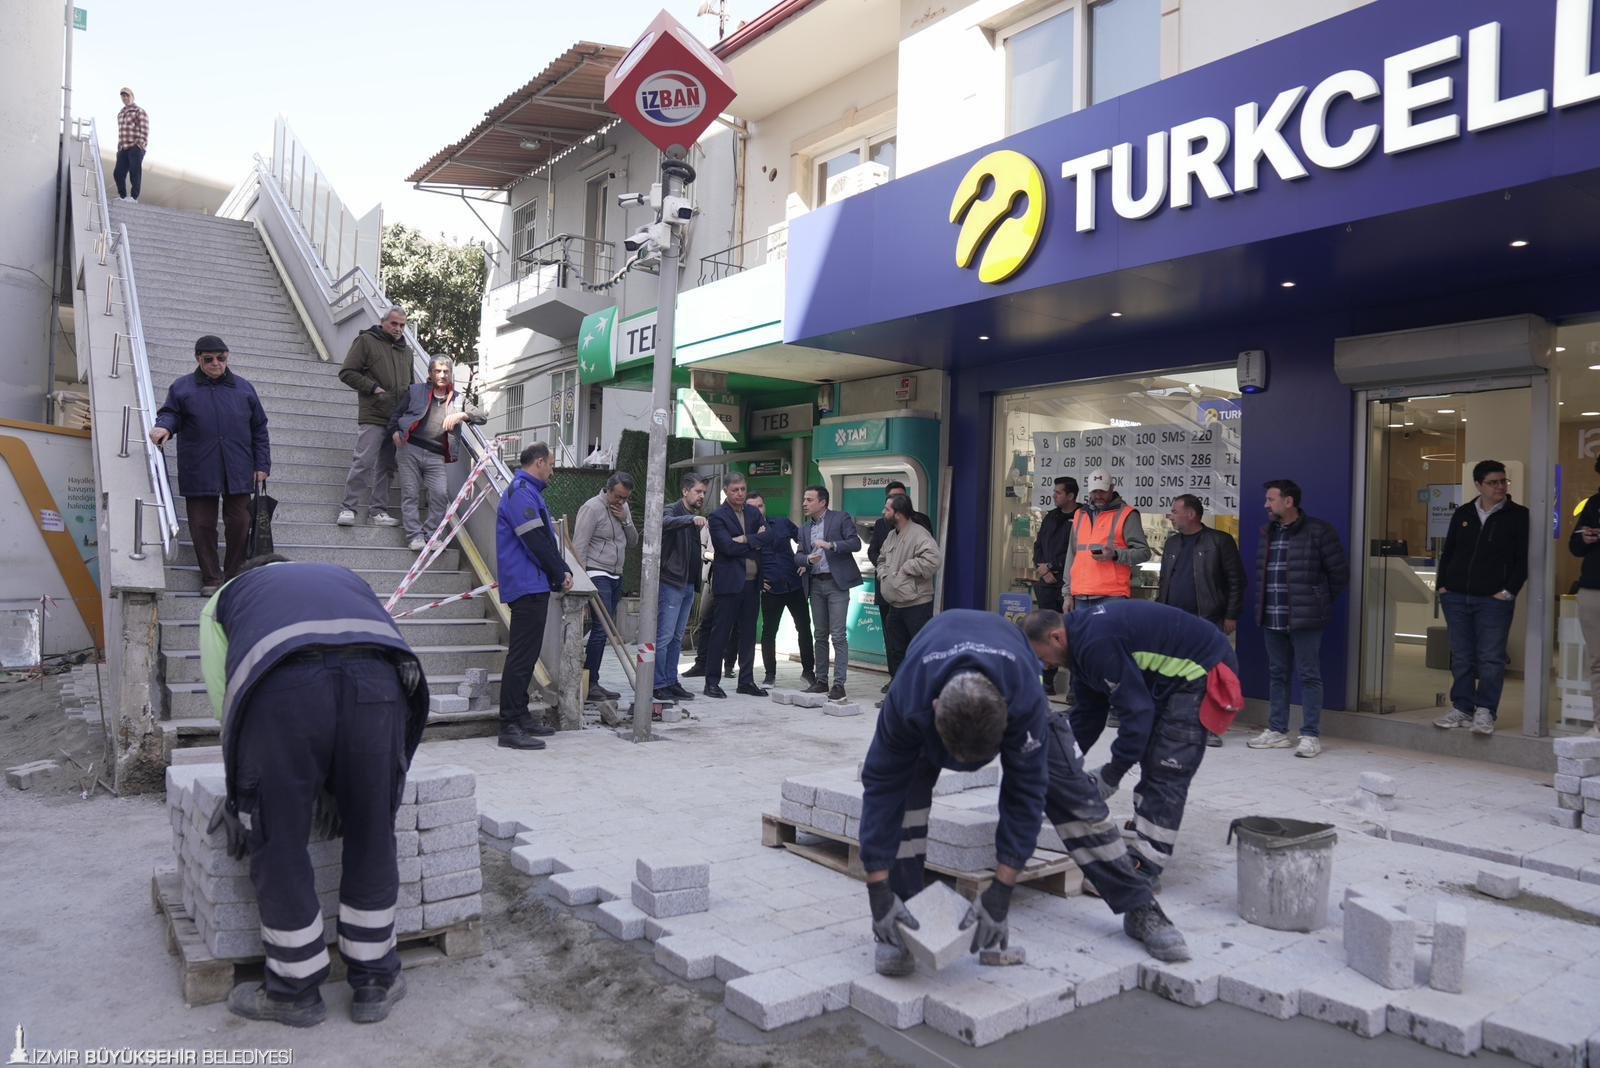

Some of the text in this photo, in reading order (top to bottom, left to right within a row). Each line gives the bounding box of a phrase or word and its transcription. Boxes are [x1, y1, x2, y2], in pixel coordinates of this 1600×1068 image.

[1061, 0, 1600, 233] TURKCELL
[626, 323, 658, 355] TE
[761, 412, 789, 431] TEB
[846, 427, 867, 441] TAM
[1042, 438, 1050, 449] 8
[1063, 438, 1076, 448] GB
[1085, 435, 1103, 447] 500
[1112, 434, 1127, 446] DK
[1136, 432, 1156, 445] 100
[1161, 431, 1186, 443] SMS
[1041, 452, 1240, 468] 12 GB 500 DK 100 SMS 286 TL
[1041, 476, 1053, 487] 20
[1135, 476, 1154, 487] 100
[1160, 476, 1184, 487] SMS
[1189, 475, 1211, 489] 374
[1224, 474, 1238, 487] TL
[1040, 495, 1052, 506] 30
[1134, 496, 1153, 507] 100
[1159, 496, 1176, 507] SM
[1223, 495, 1237, 508] TL
